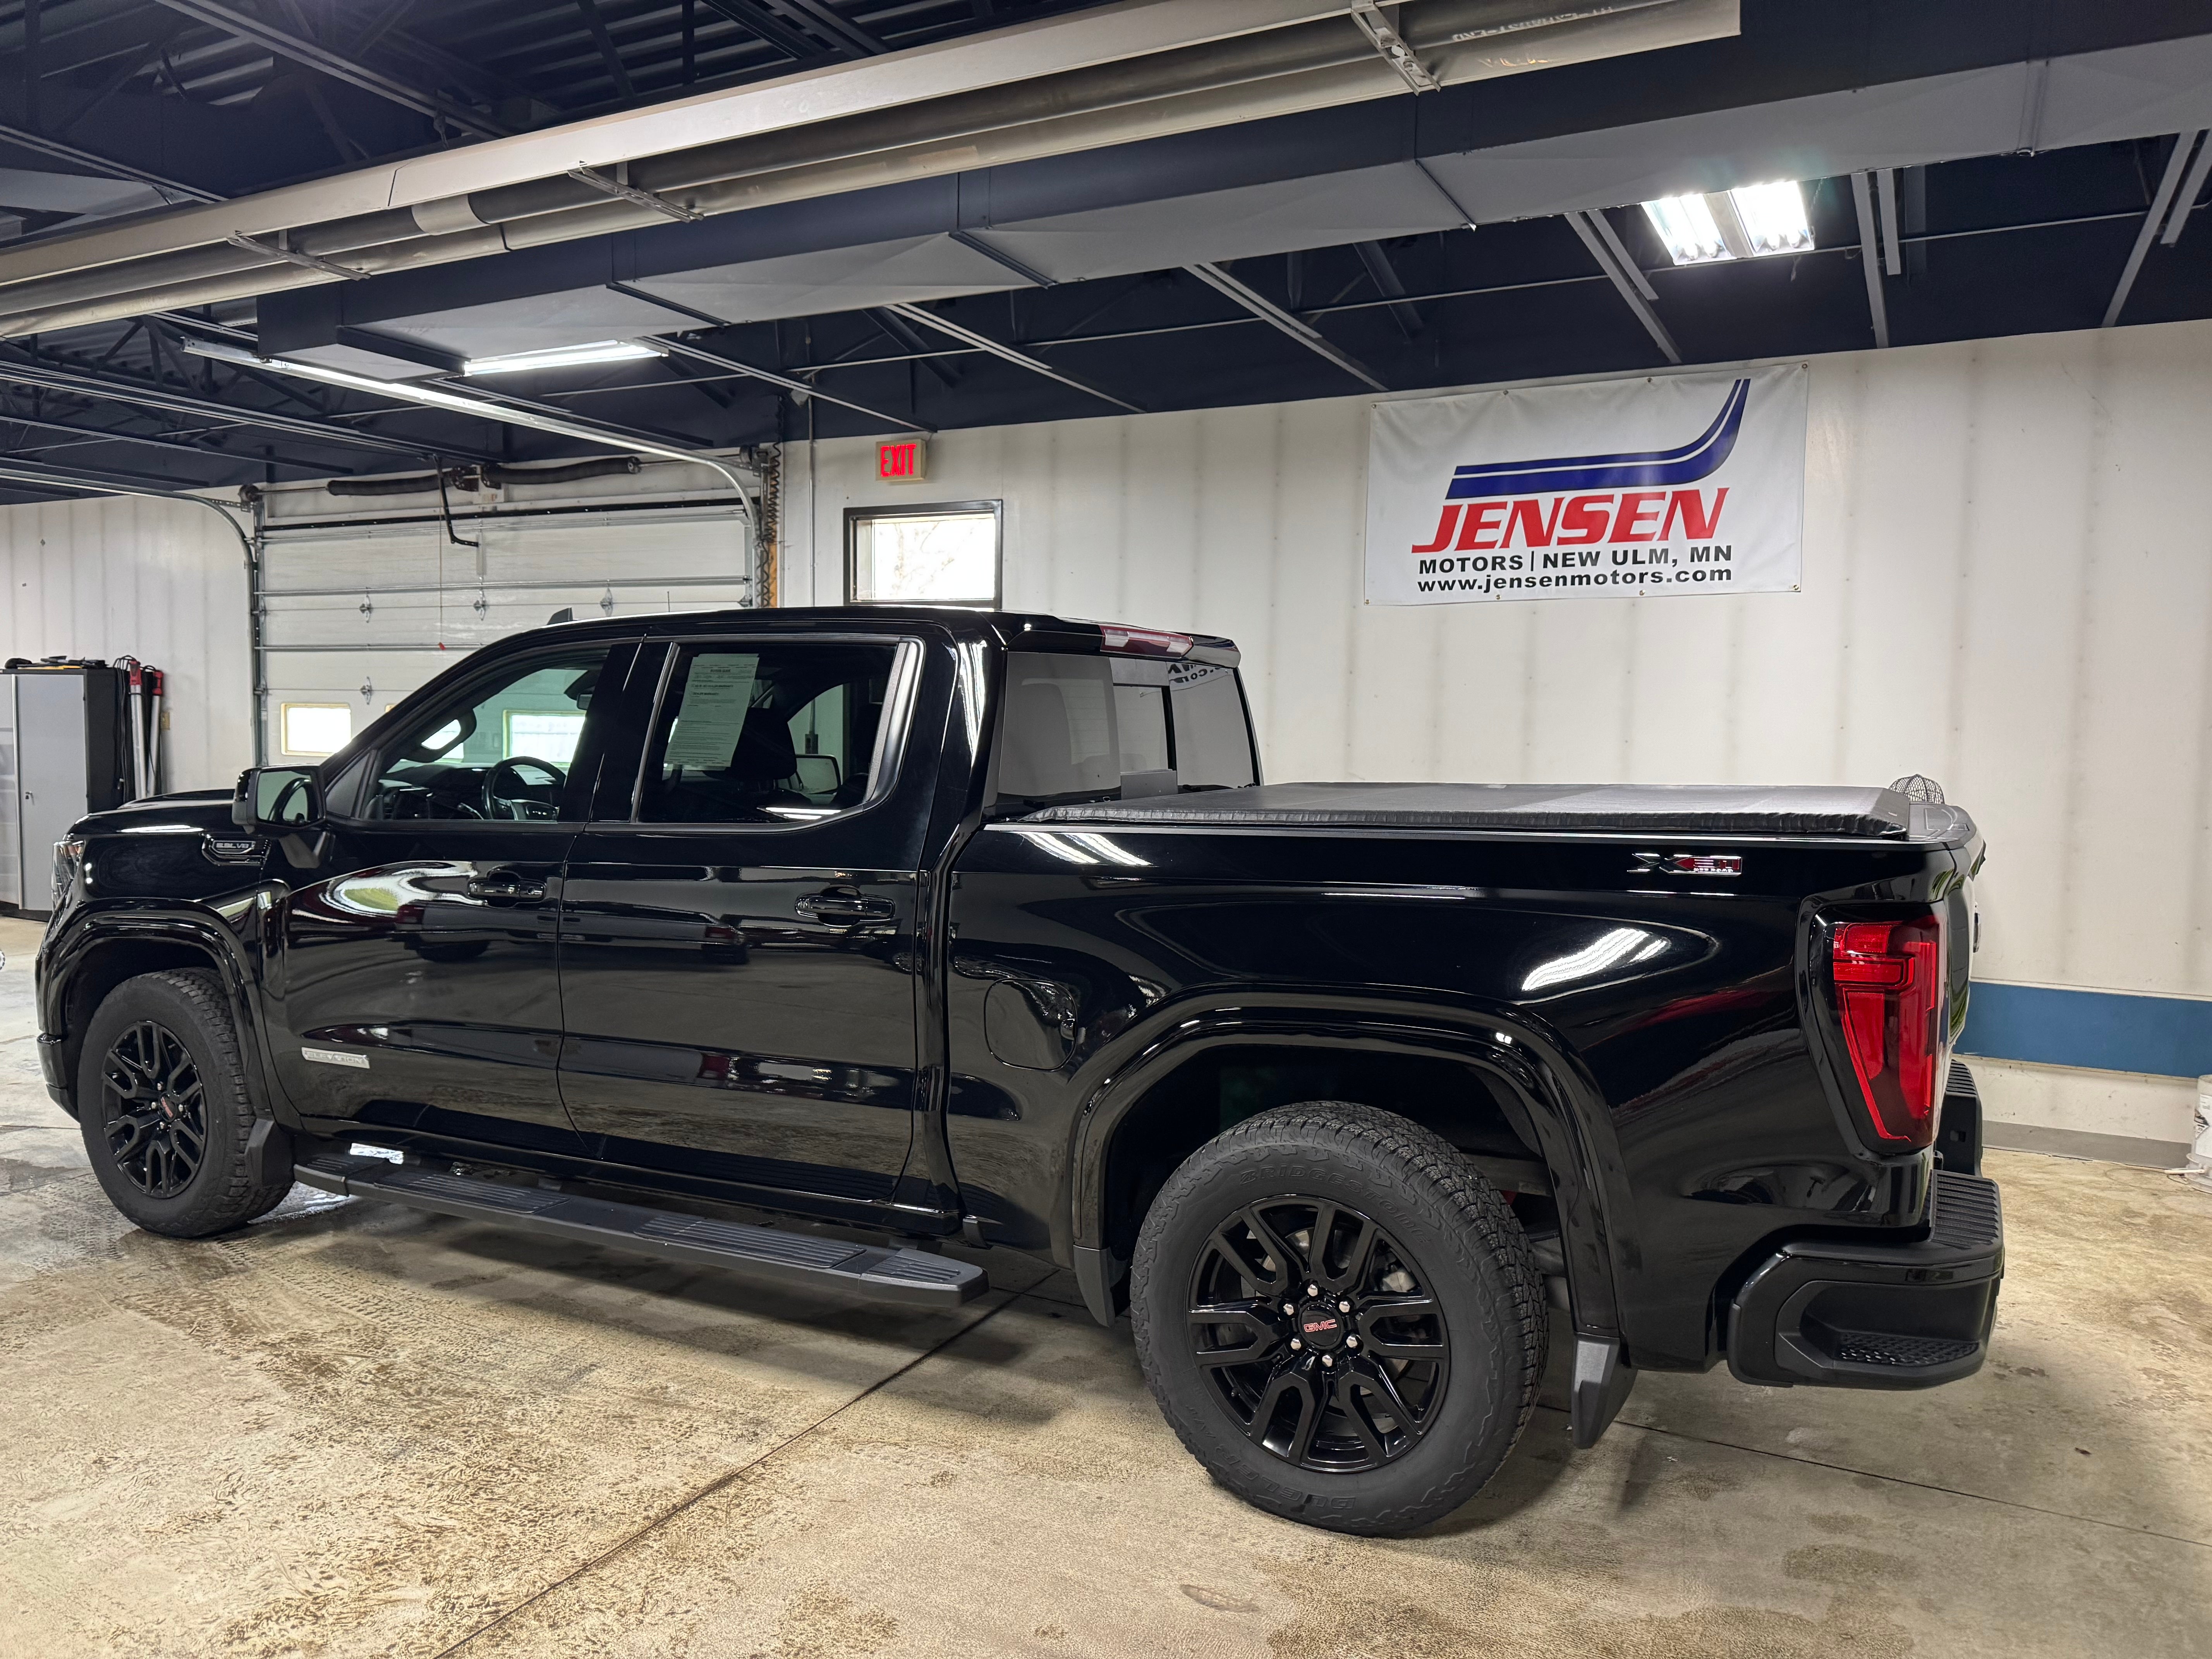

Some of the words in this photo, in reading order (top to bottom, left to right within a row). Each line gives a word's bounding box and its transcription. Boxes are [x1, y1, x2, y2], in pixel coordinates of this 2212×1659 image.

[881, 443, 917, 477] EXIT
[1412, 488, 1729, 553] JENSEN
[1419, 555, 1523, 574] MOTORS
[1543, 551, 1601, 568] NEW
[1612, 548, 1678, 567] ULM,
[1690, 545, 1731, 563] MN
[1417, 569, 1731, 593] www.jensenmotors.com
[1304, 1319, 1337, 1333] GMC
